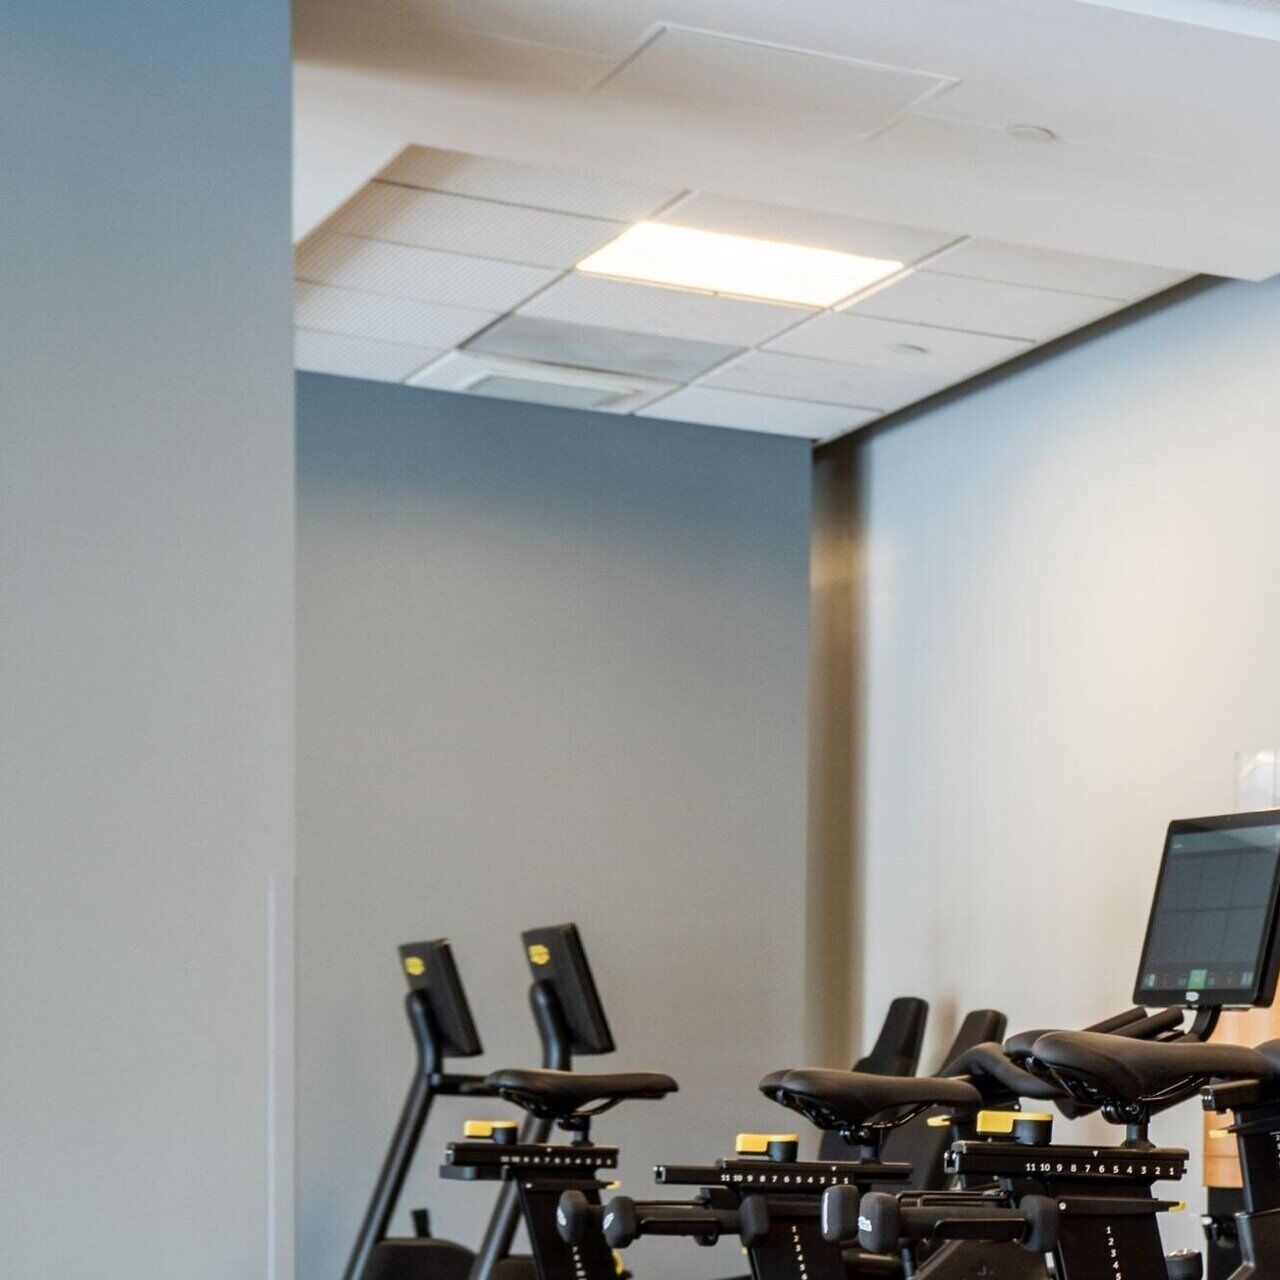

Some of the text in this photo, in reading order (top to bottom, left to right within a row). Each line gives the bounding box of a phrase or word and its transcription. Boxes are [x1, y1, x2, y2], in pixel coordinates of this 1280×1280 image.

[1026, 1163, 1036, 1171] 11
[1040, 1163, 1050, 1171] 10
[1056, 1164, 1063, 1172] 9
[1071, 1164, 1077, 1172] 8
[1085, 1164, 1090, 1173] 7
[1099, 1165, 1105, 1173] 6
[1113, 1165, 1119, 1173] 5
[1141, 1166, 1147, 1174] 3
[1155, 1167, 1160, 1175] 2
[1169, 1167, 1174, 1175] 1
[733, 1174, 743, 1182] 10
[843, 1177, 849, 1185] 1
[1106, 1226, 1111, 1234] 1
[1111, 1249, 1116, 1257] 3
[1113, 1261, 1119, 1269] 4
[1116, 1273, 1121, 1280] 5
